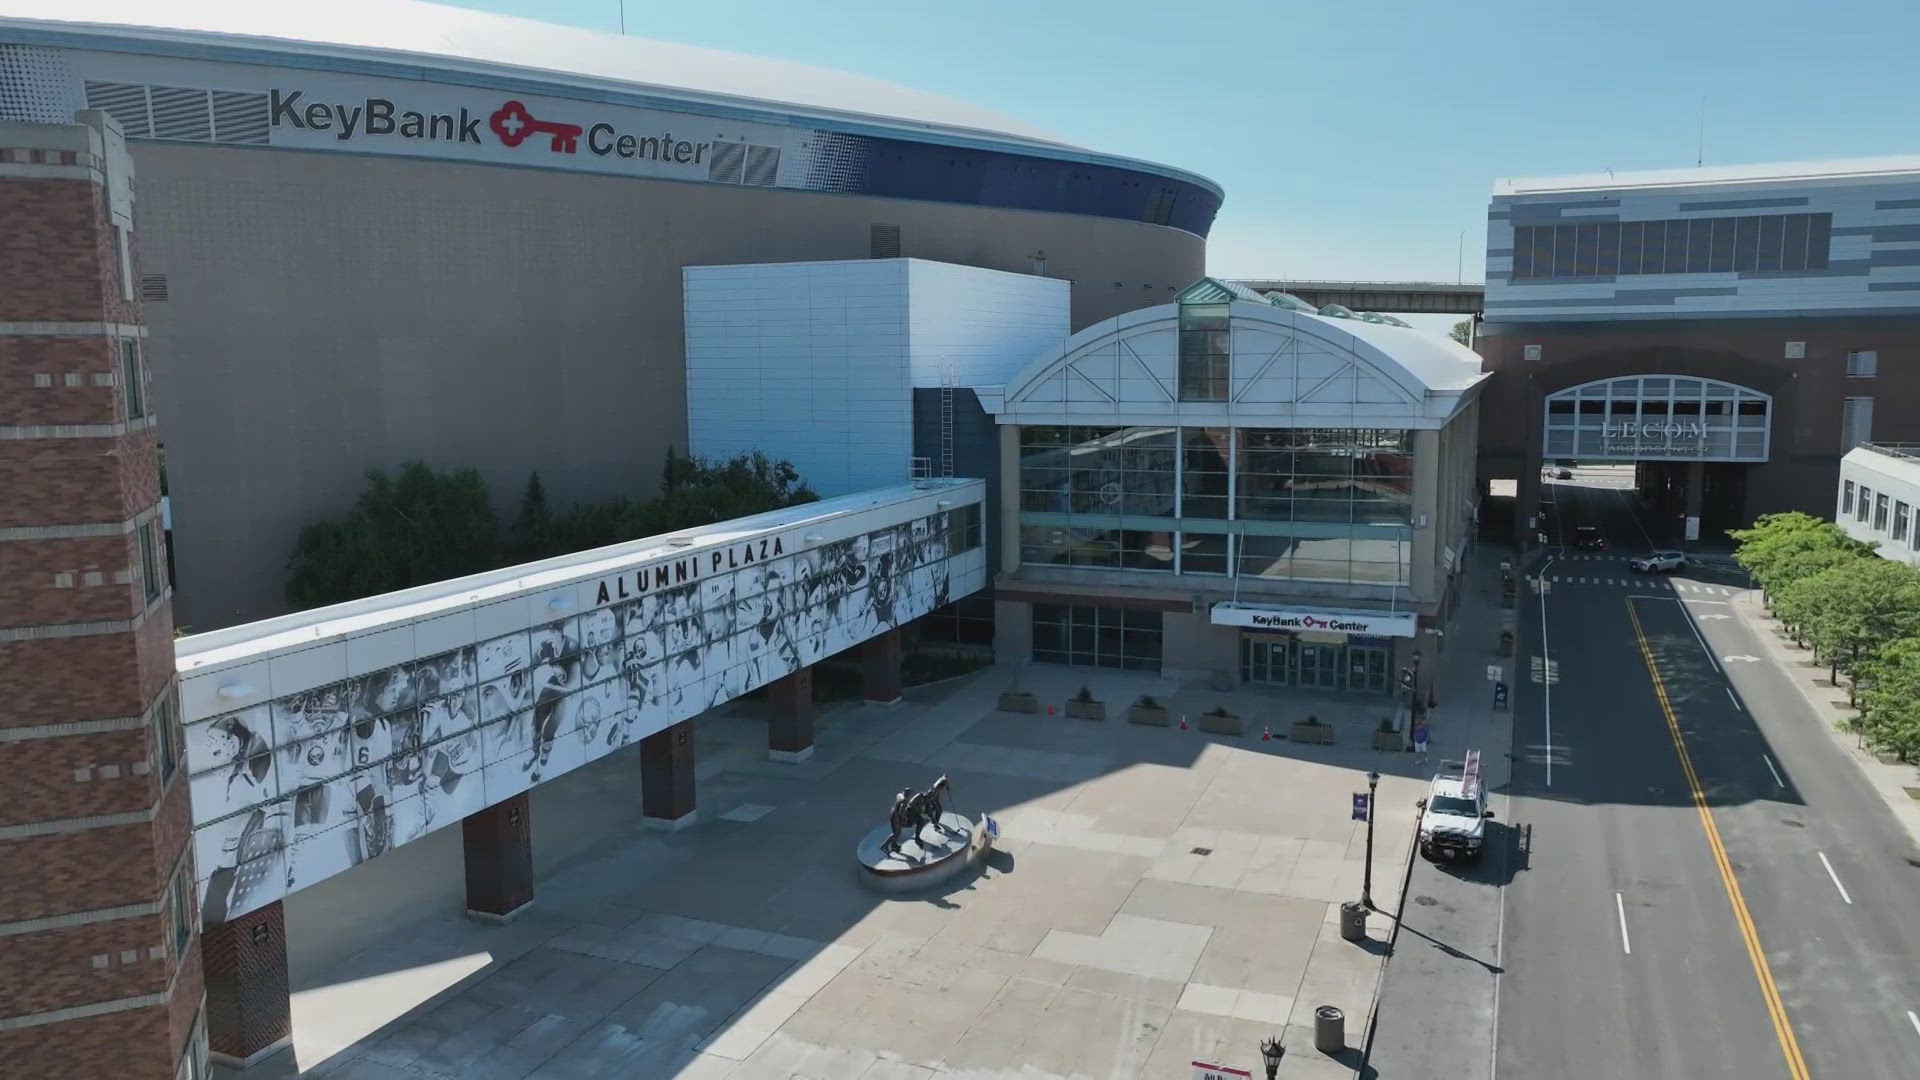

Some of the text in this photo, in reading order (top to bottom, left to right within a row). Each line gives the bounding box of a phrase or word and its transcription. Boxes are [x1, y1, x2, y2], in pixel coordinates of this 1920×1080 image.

[270, 88, 709, 164] KeyBank Center
[1601, 421, 1709, 439] LECOM
[596, 537, 783, 605] ALUMNI PLAZA
[1252, 615, 1368, 632] KeyBank Center
